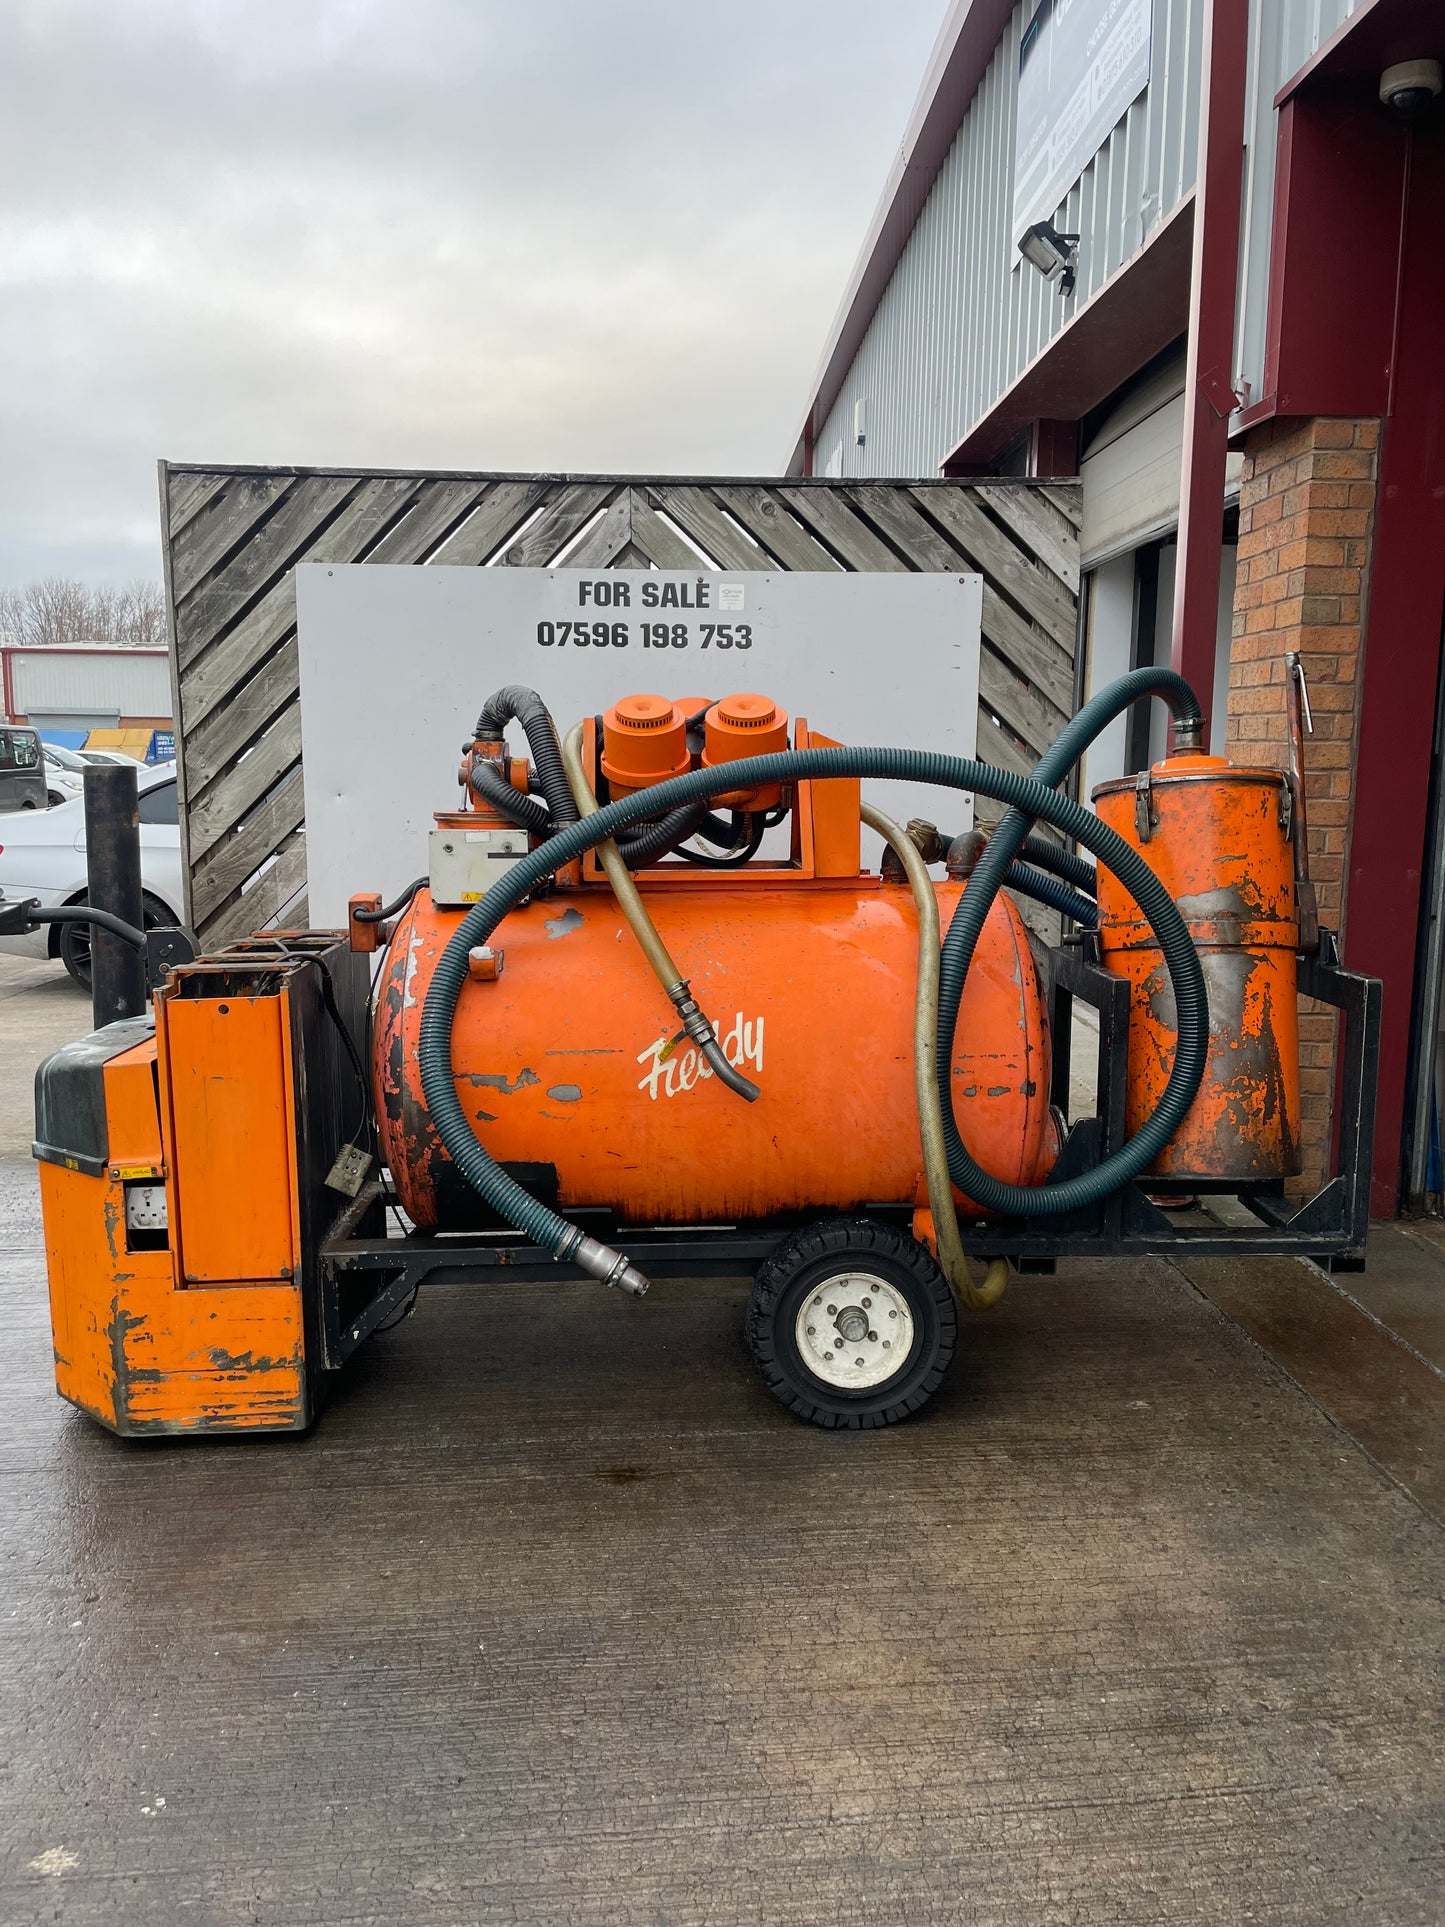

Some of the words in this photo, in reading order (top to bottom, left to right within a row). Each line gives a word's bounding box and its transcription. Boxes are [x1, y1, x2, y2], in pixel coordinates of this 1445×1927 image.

[579, 581, 630, 607] FOR
[642, 583, 710, 608] SALE
[537, 621, 629, 647] 07596
[640, 623, 688, 648] 198
[699, 624, 753, 650] 753
